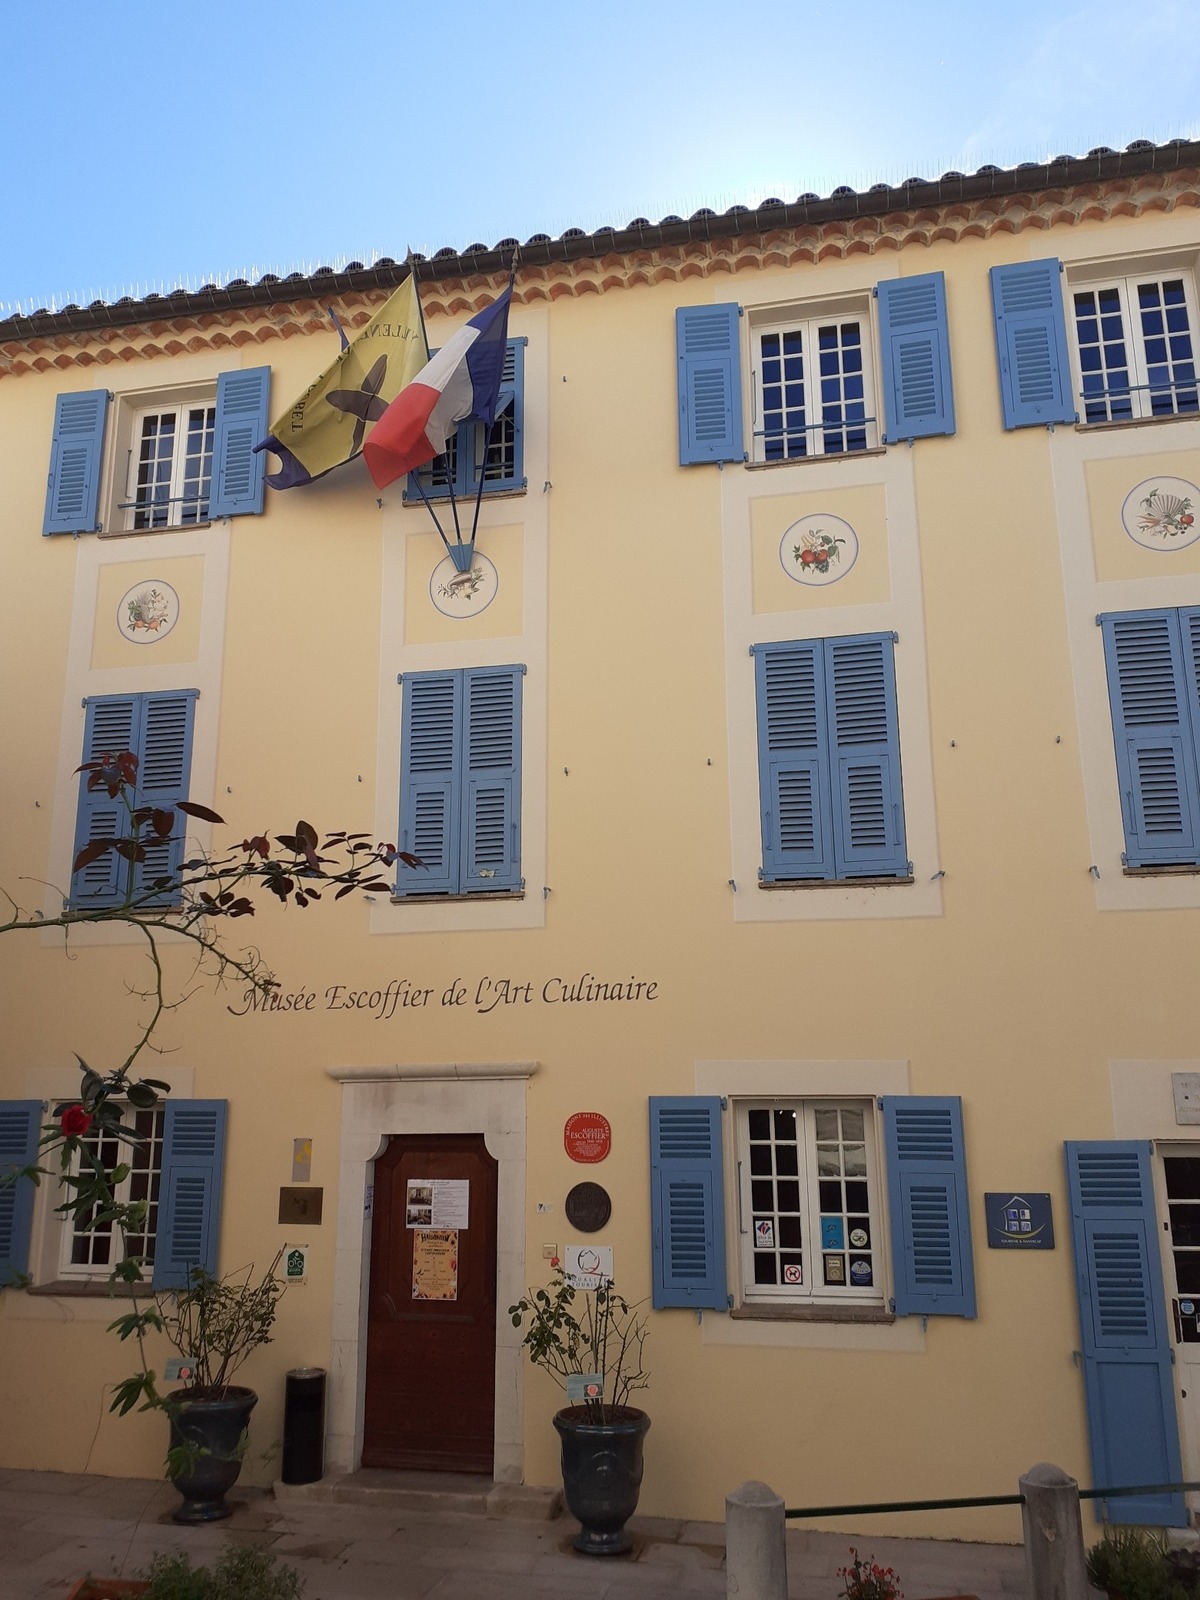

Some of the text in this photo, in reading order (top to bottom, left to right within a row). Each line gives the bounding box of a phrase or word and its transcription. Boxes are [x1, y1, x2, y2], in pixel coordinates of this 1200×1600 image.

[227, 973, 659, 1020] Musée Escoffier de l'Art Culinaire
